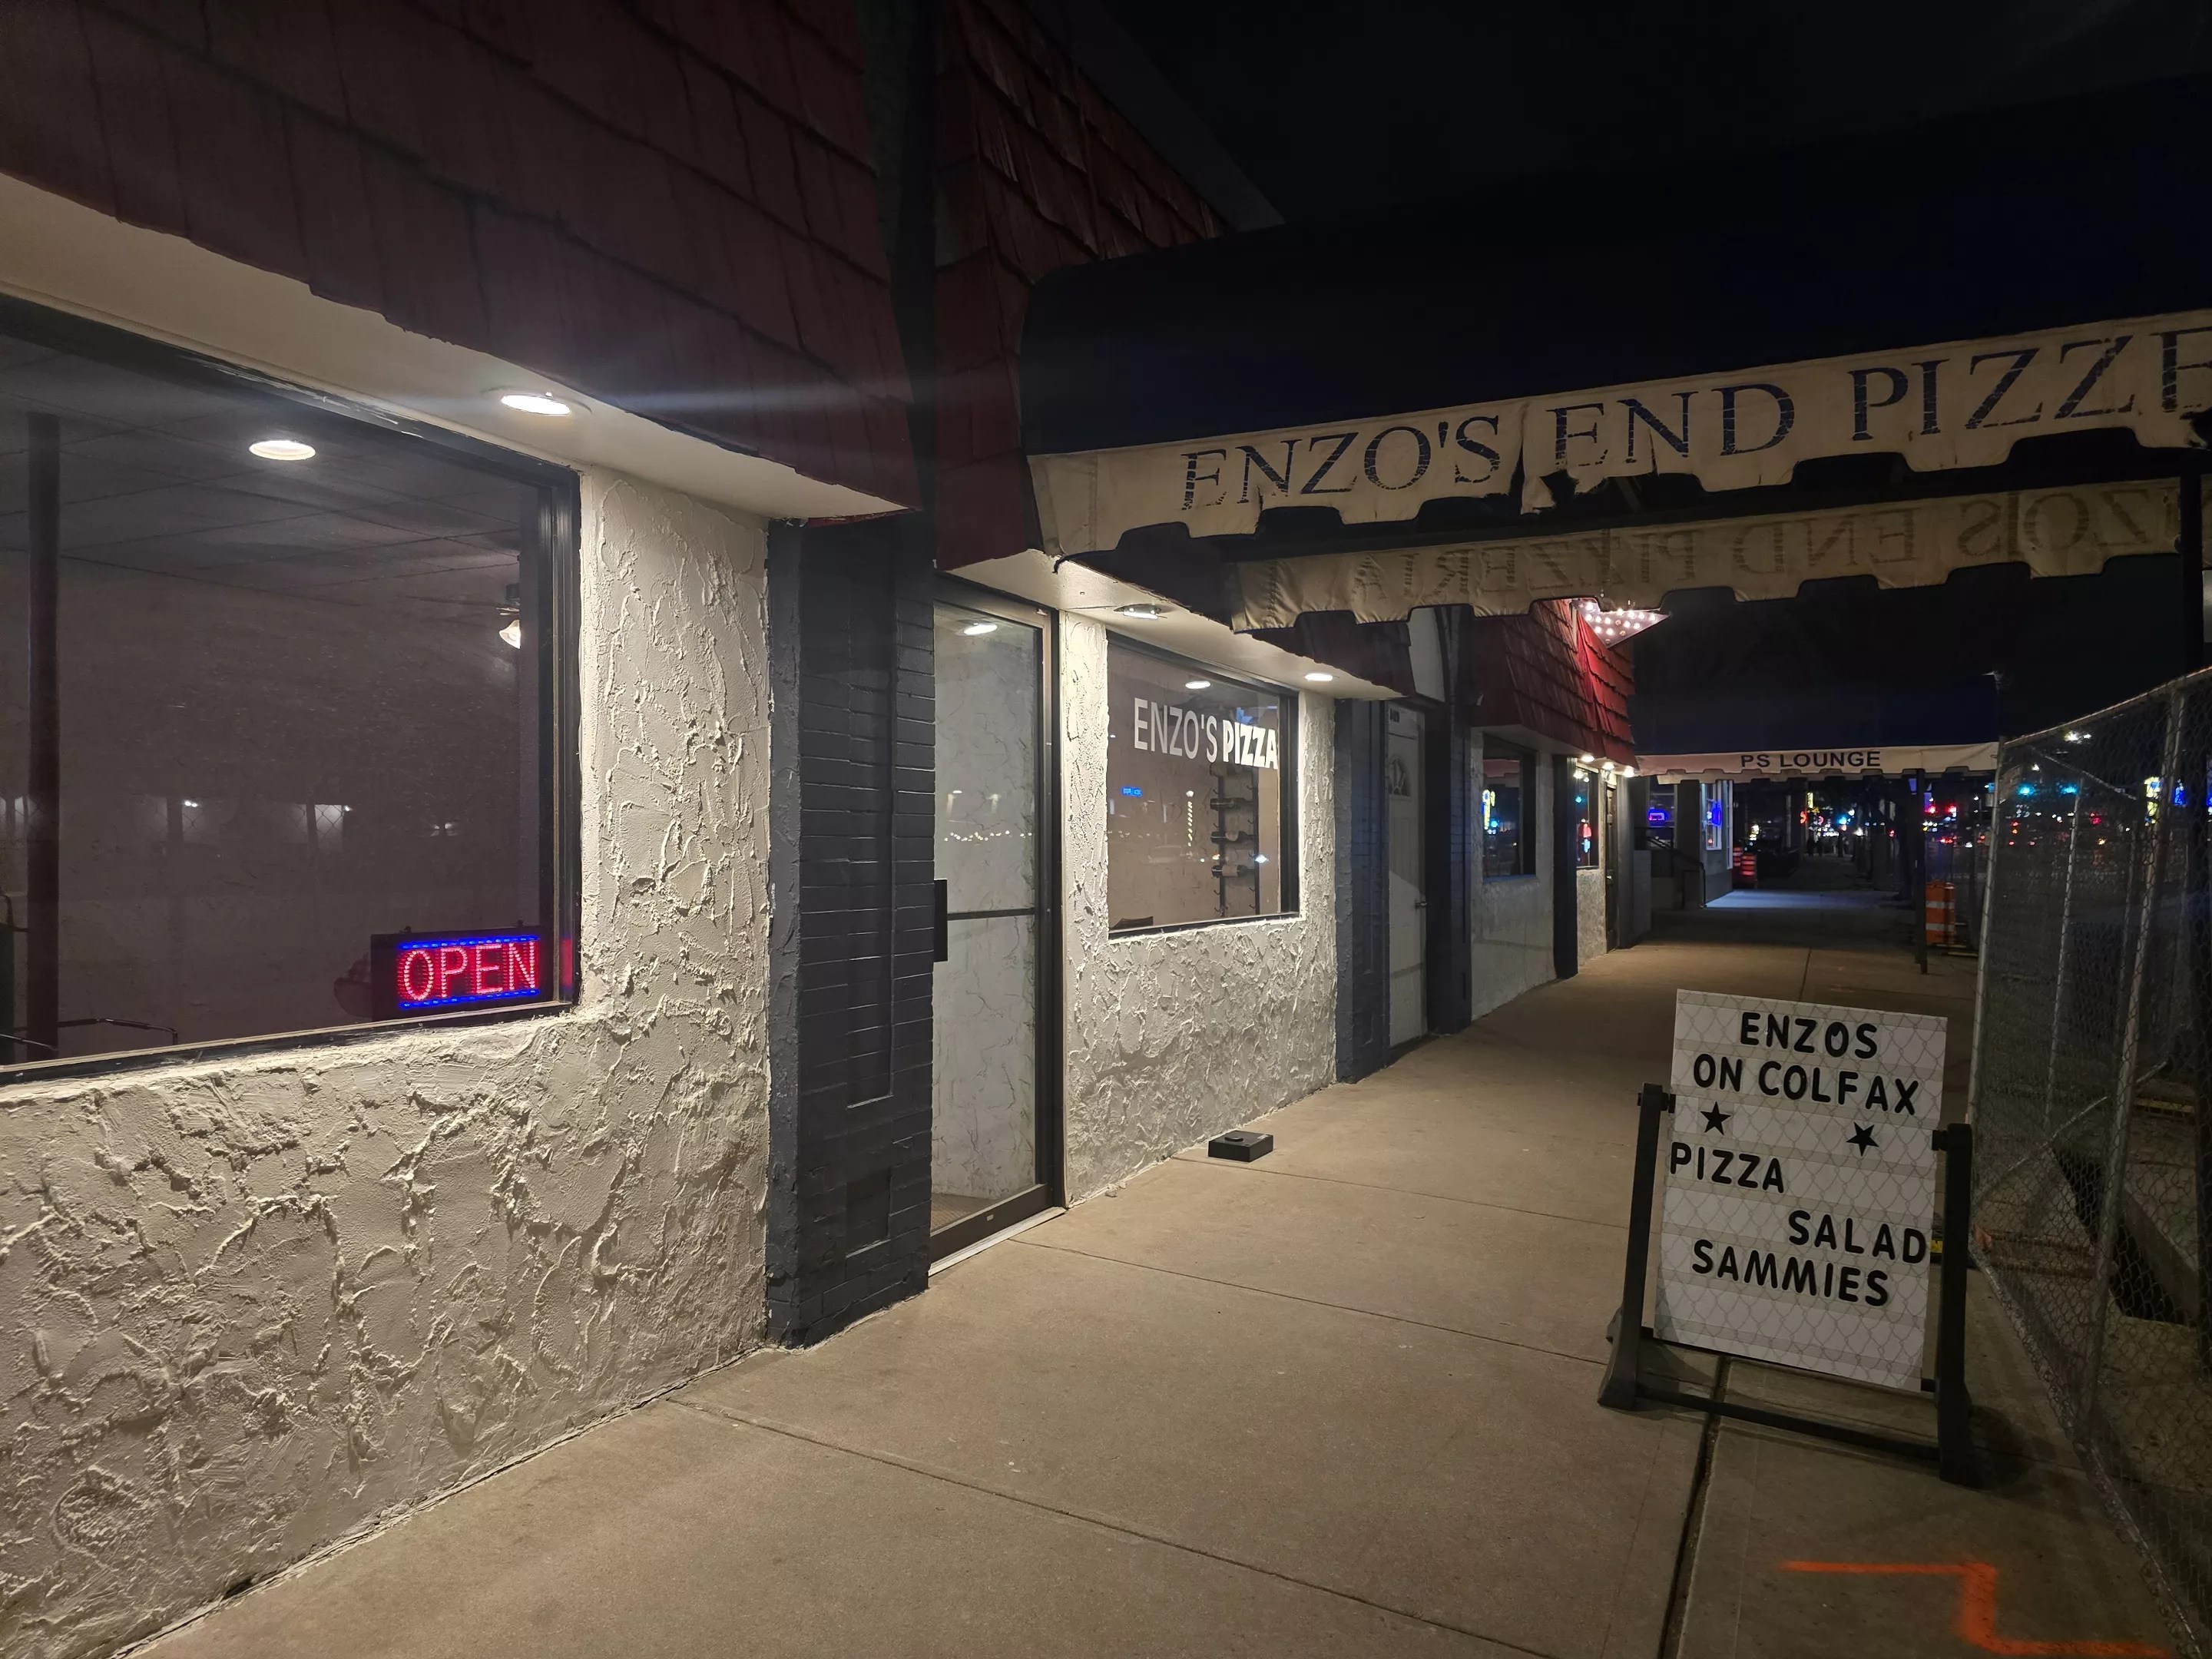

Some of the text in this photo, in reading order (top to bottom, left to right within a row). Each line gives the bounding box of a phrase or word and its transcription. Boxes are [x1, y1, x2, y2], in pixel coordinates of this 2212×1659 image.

[1181, 416, 1501, 511] ENZO'S
[1546, 382, 1795, 469] END
[1134, 697, 1278, 769] ENZO'S PIZZA
[1741, 751, 1880, 767] PS LOUNGE
[402, 940, 536, 1000] OPEN
[1740, 1012, 1877, 1059] ENZOS
[1694, 1054, 1919, 1115] ON COLFAX
[1670, 1142, 1784, 1194] PIZZA
[1788, 1210, 1926, 1264] SALAD
[1692, 1240, 1889, 1306] SAMMIES
